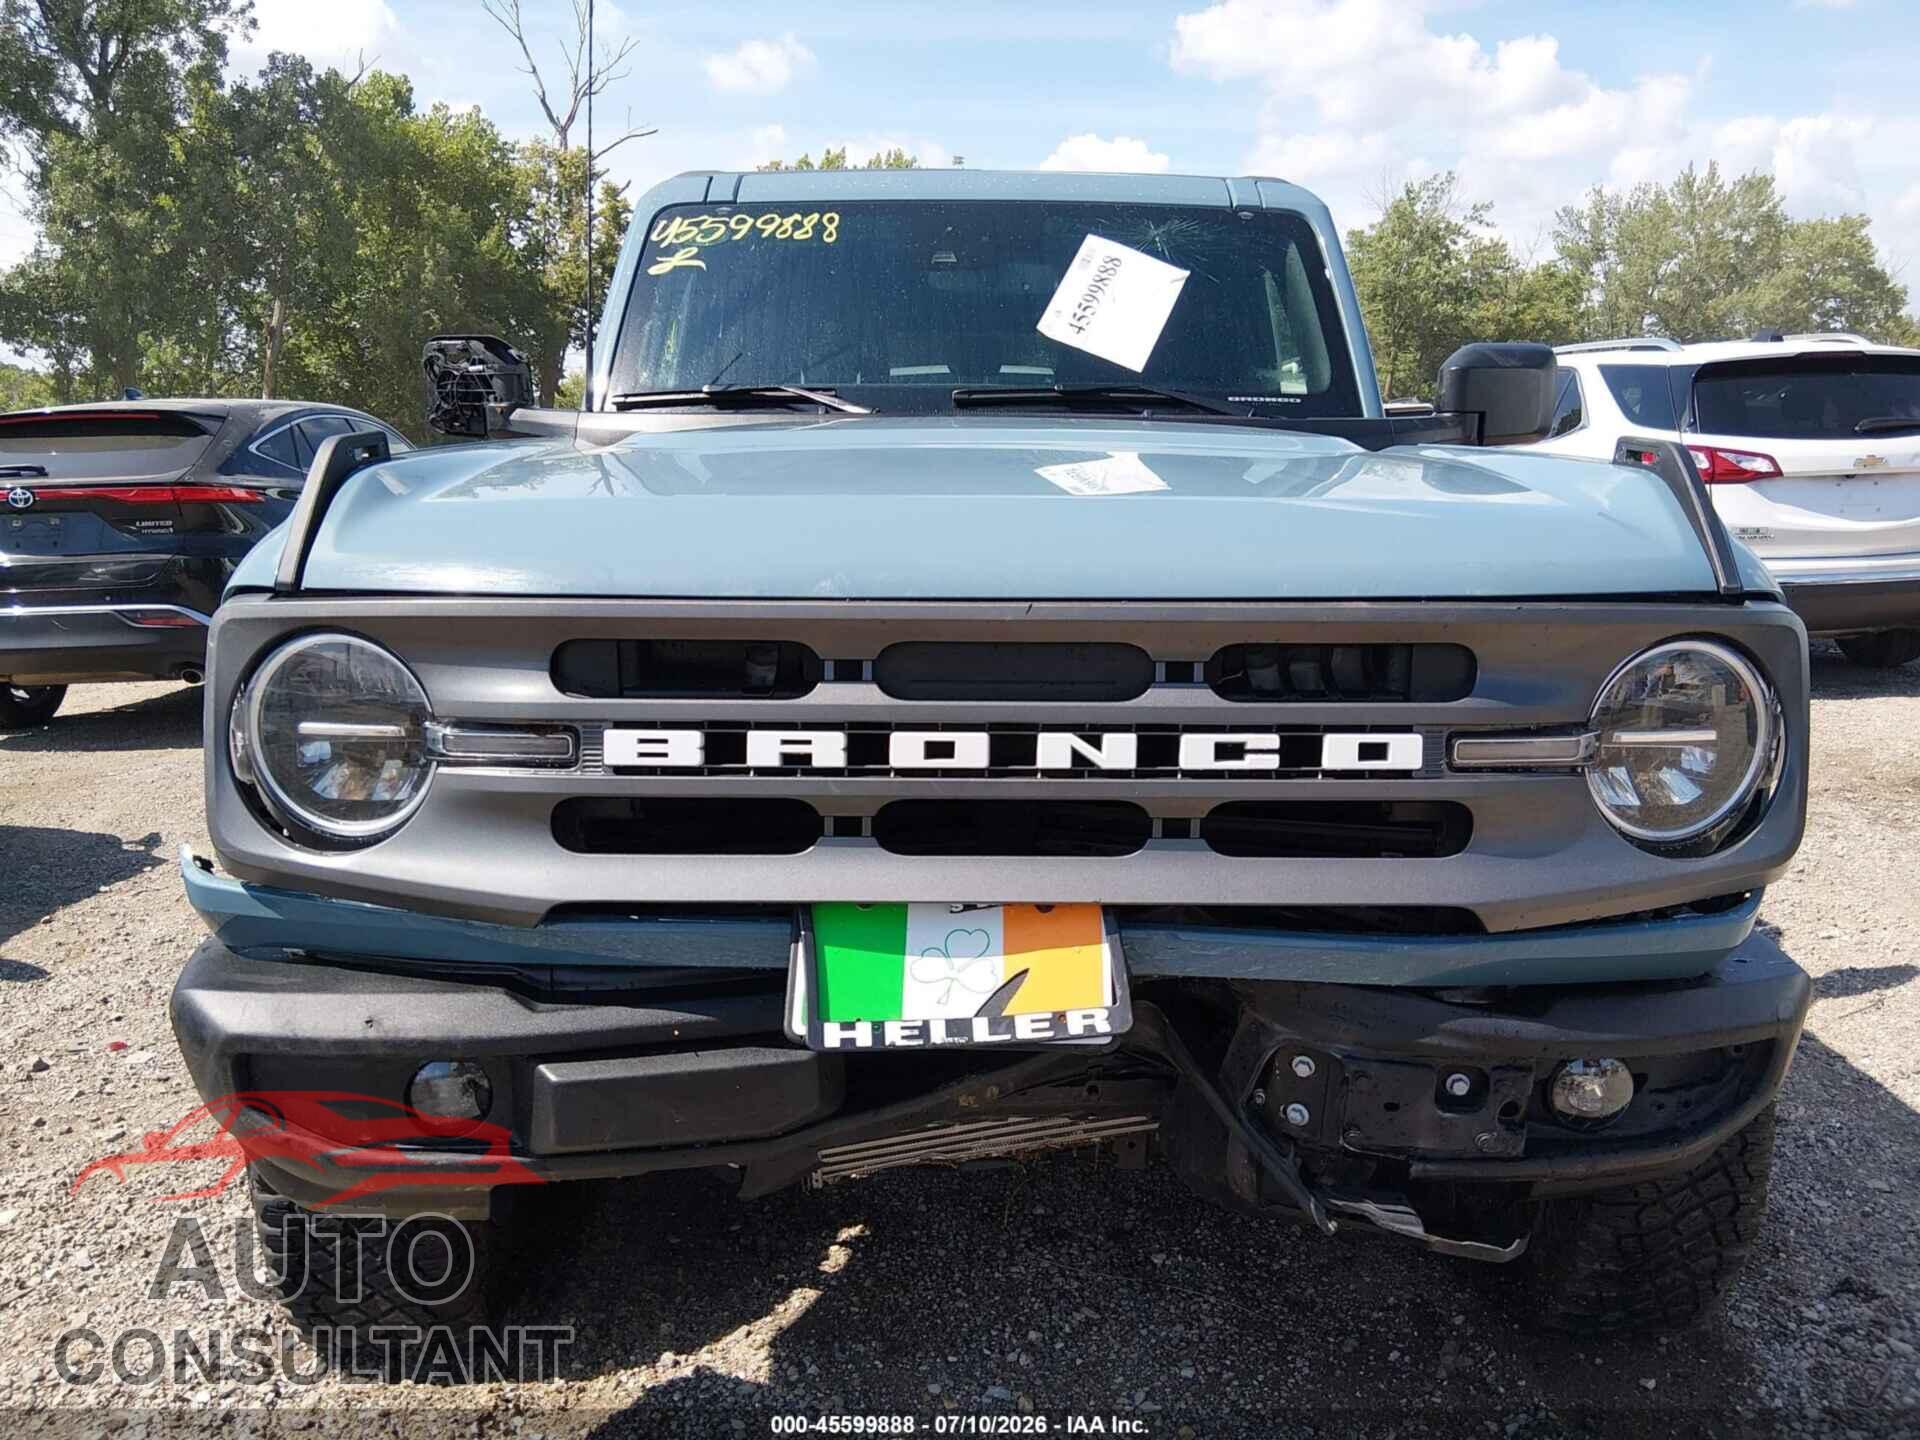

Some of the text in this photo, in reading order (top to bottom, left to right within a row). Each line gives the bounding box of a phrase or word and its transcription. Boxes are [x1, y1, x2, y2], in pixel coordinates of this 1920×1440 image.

[1067, 255, 1123, 335] 45599888
[602, 728, 1423, 770] BRONCO
[822, 1007, 1113, 1049] HELLER
